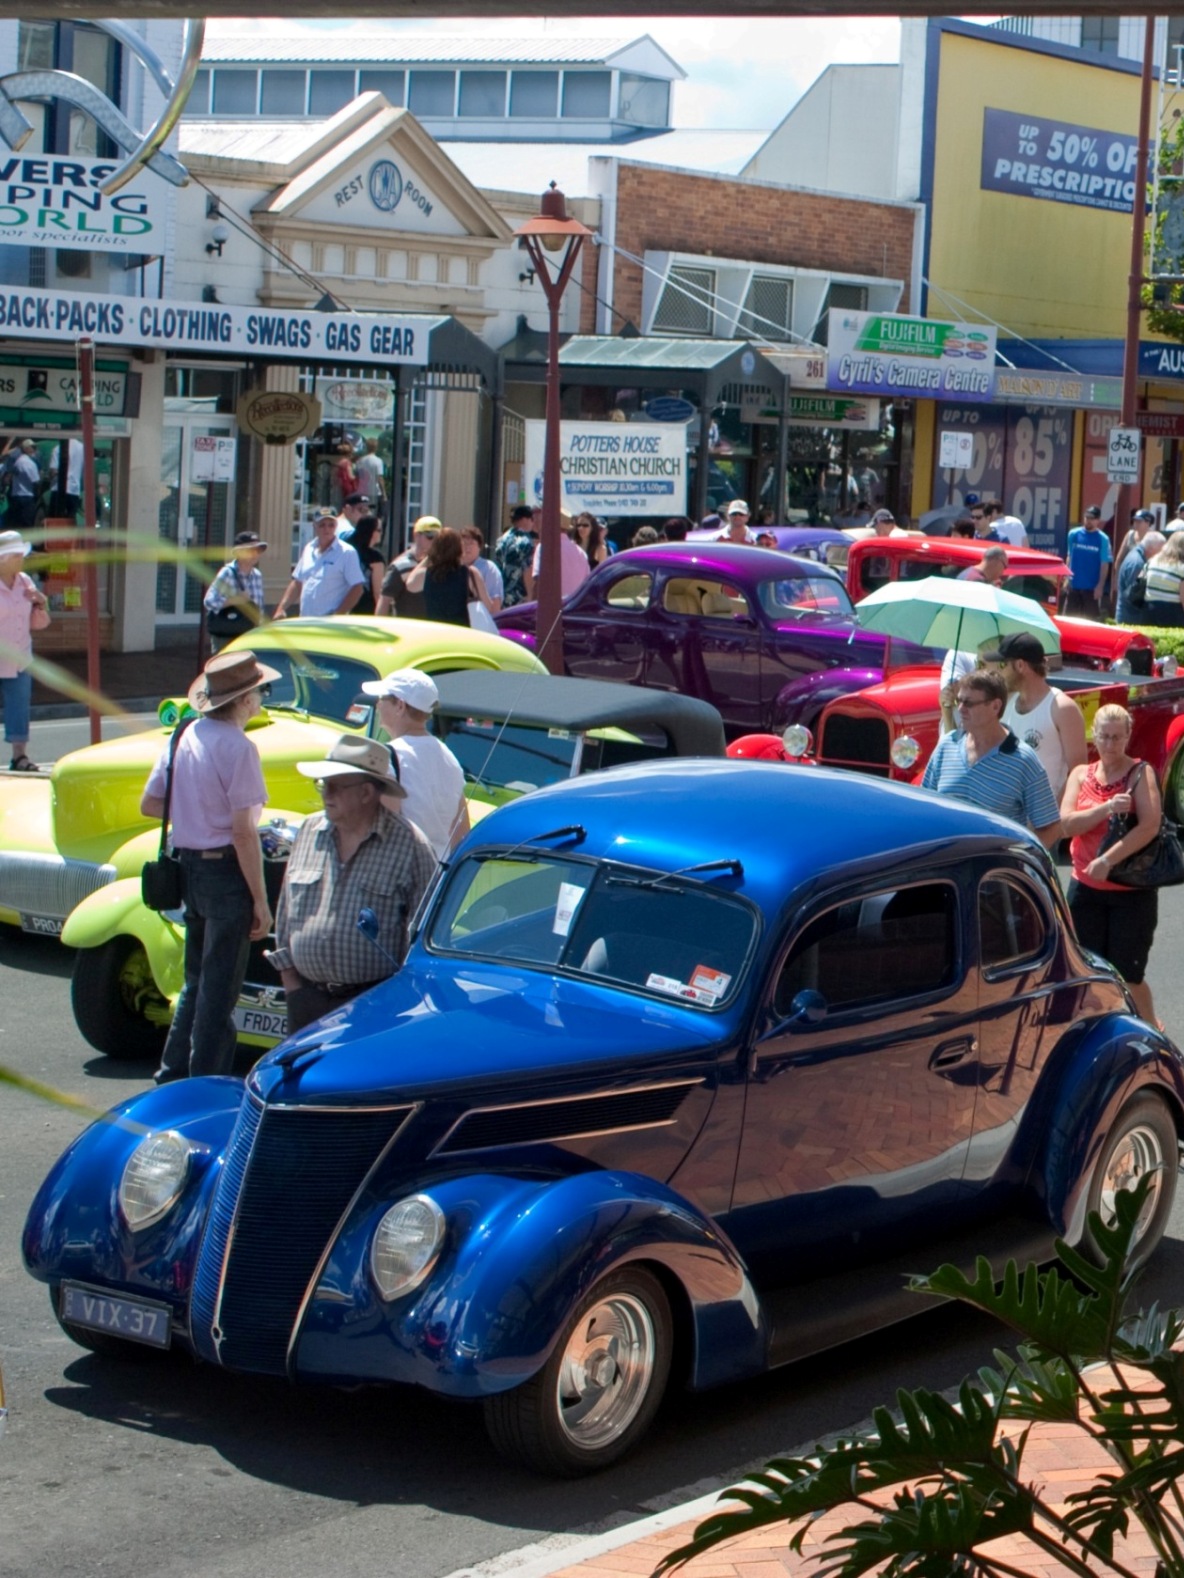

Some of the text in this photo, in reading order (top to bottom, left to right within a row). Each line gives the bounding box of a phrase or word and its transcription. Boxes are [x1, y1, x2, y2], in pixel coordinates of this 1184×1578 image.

[1018, 141, 1038, 157] TO
[1019, 124, 1040, 140] UP
[1046, 131, 1099, 168] 50%
[334, 174, 434, 218] REST ROOM
[33, 230, 129, 246] specialists
[139, 306, 232, 343] CLOTHING
[246, 315, 312, 349] SWAGS
[325, 321, 361, 352] GAS
[370, 325, 415, 356] GEAR
[880, 320, 936, 343] FUJIFILM
[806, 360, 825, 378] 261
[838, 353, 989, 393] Cyril's Camera Centre
[942, 409, 980, 424] UP TO
[570, 435, 662, 453] POTTERS HOUSE
[1013, 416, 1067, 476] 85%
[560, 456, 681, 476] CHRISTIAN CHURCH
[1110, 455, 1137, 469] LANE
[1113, 473, 1132, 483] END
[1012, 486, 1062, 531] OFF
